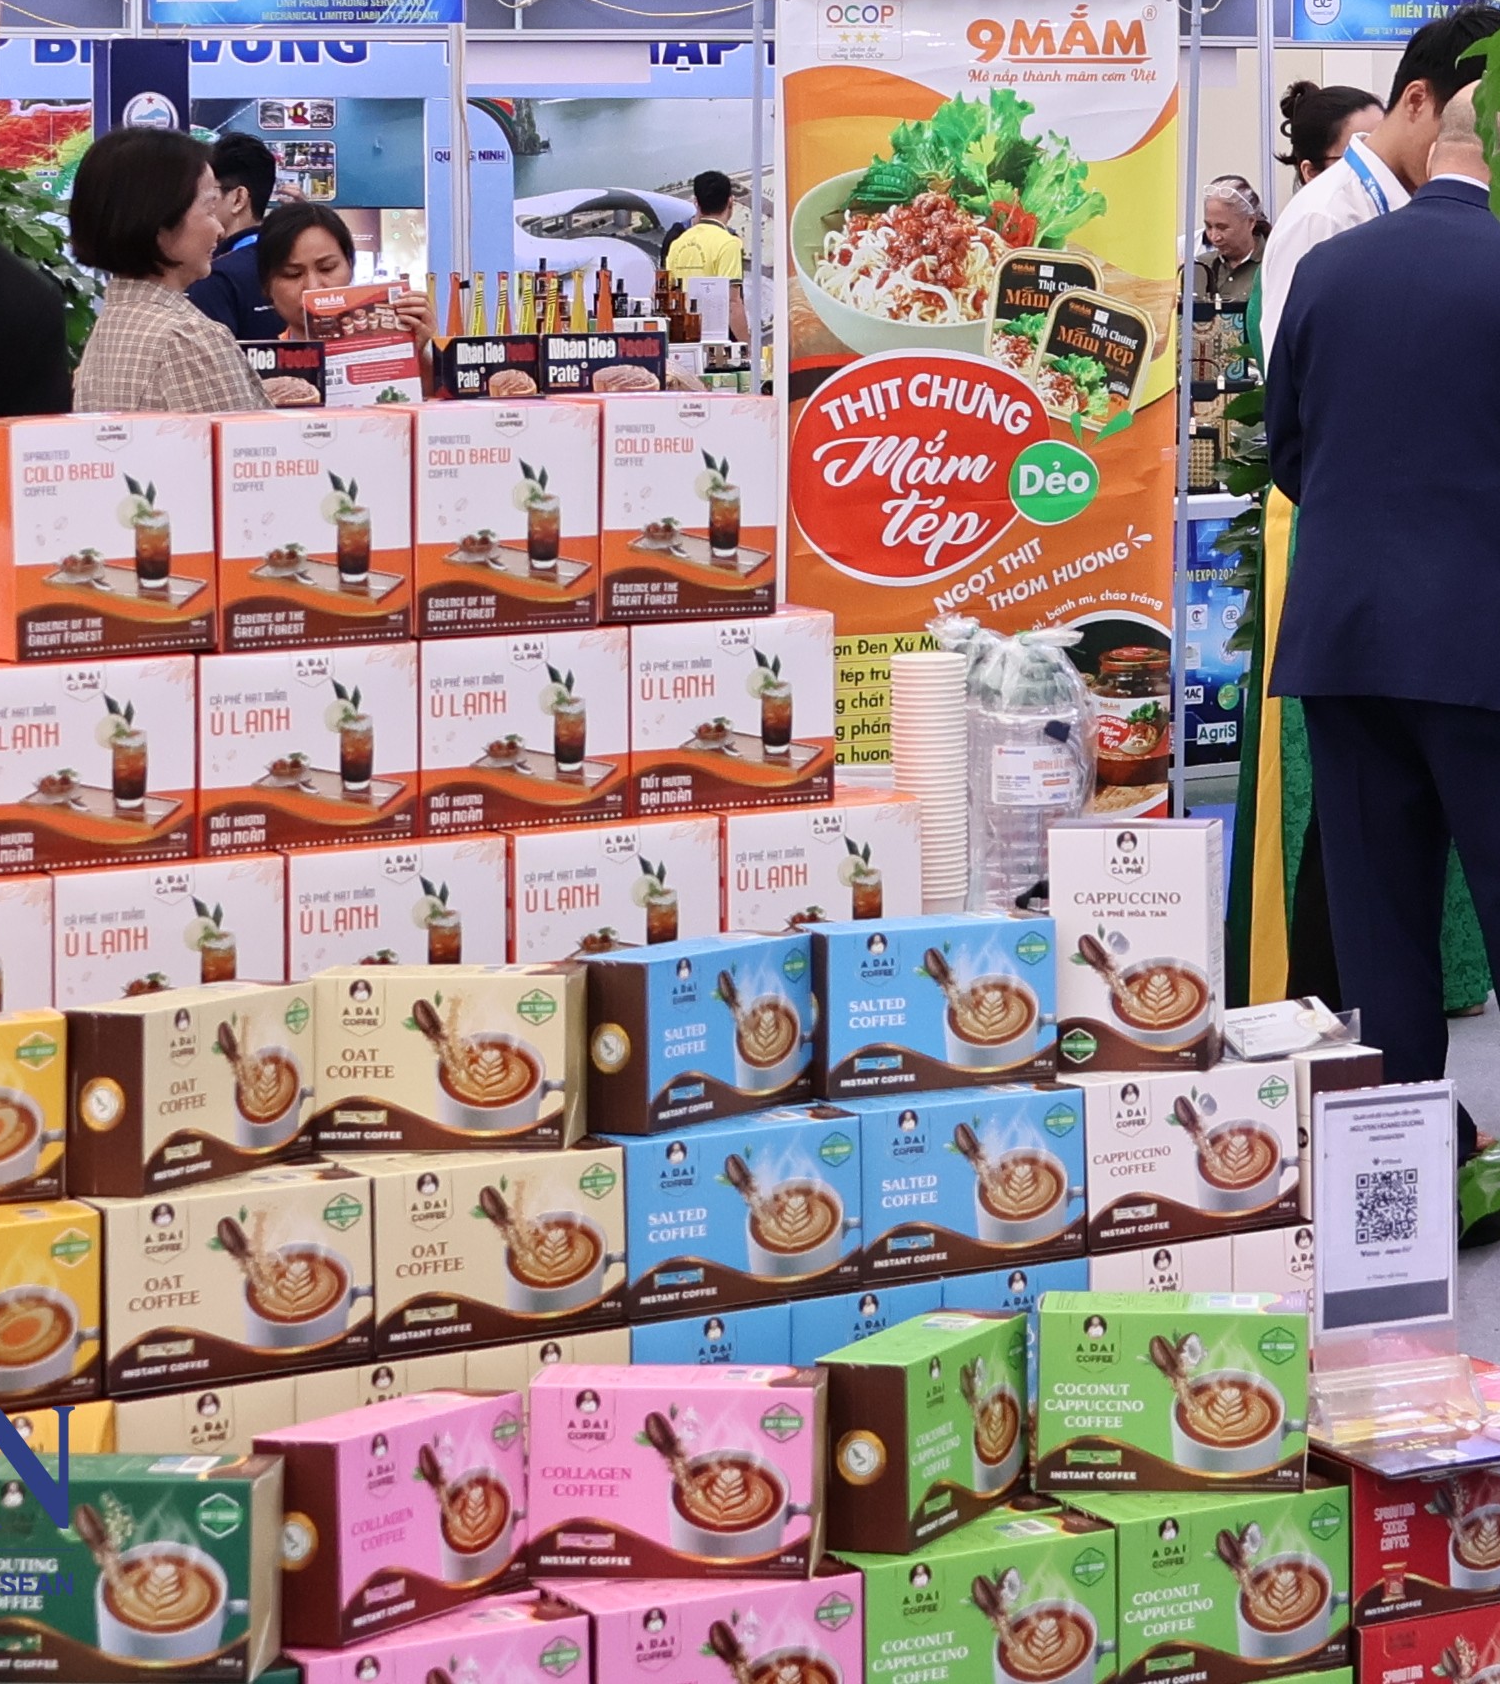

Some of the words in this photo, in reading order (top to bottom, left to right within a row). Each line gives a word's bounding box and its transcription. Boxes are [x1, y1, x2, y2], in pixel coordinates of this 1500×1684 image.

[826, 4, 894, 24] OCOP
[966, 4, 1147, 63] 9MẮM
[968, 69, 990, 83] Mở
[993, 69, 1018, 86] nắp
[1023, 68, 1062, 83] thành
[1066, 71, 1098, 83] mâm
[1102, 73, 1126, 83] cơm
[1131, 68, 1157, 85] Việt
[820, 374, 903, 432] THỊT
[908, 371, 1031, 429] CHƯNG
[813, 429, 997, 490] Mắm
[1019, 462, 1090, 496] Dẻo
[882, 488, 990, 566] tép
[933, 565, 996, 614] NGỌT
[998, 537, 1043, 574] THỊT
[986, 574, 1049, 612] THƠM
[1052, 542, 1129, 586] HƯƠNG
[1046, 599, 1076, 619] bánh
[1079, 592, 1096, 606] mì,
[1100, 589, 1127, 602] cháo
[1130, 590, 1164, 611] trắng
[1198, 723, 1237, 742] AgriS
[1073, 890, 1182, 906] CAPPUCCINO
[848, 997, 906, 1014] SALTED
[849, 1011, 907, 1029] COFFEE
[341, 1048, 379, 1064] OAT
[326, 1063, 396, 1080] COFFEE
[841, 1074, 877, 1089] INSTANT
[879, 1072, 916, 1087] COFFEE
[1053, 1382, 1131, 1398] COCONUT
[1044, 1398, 1145, 1414] CAPPUCCINO
[1064, 1413, 1124, 1429] COFFEE
[541, 1466, 633, 1481] COLLAGEN
[553, 1483, 620, 1498] COFFEE
